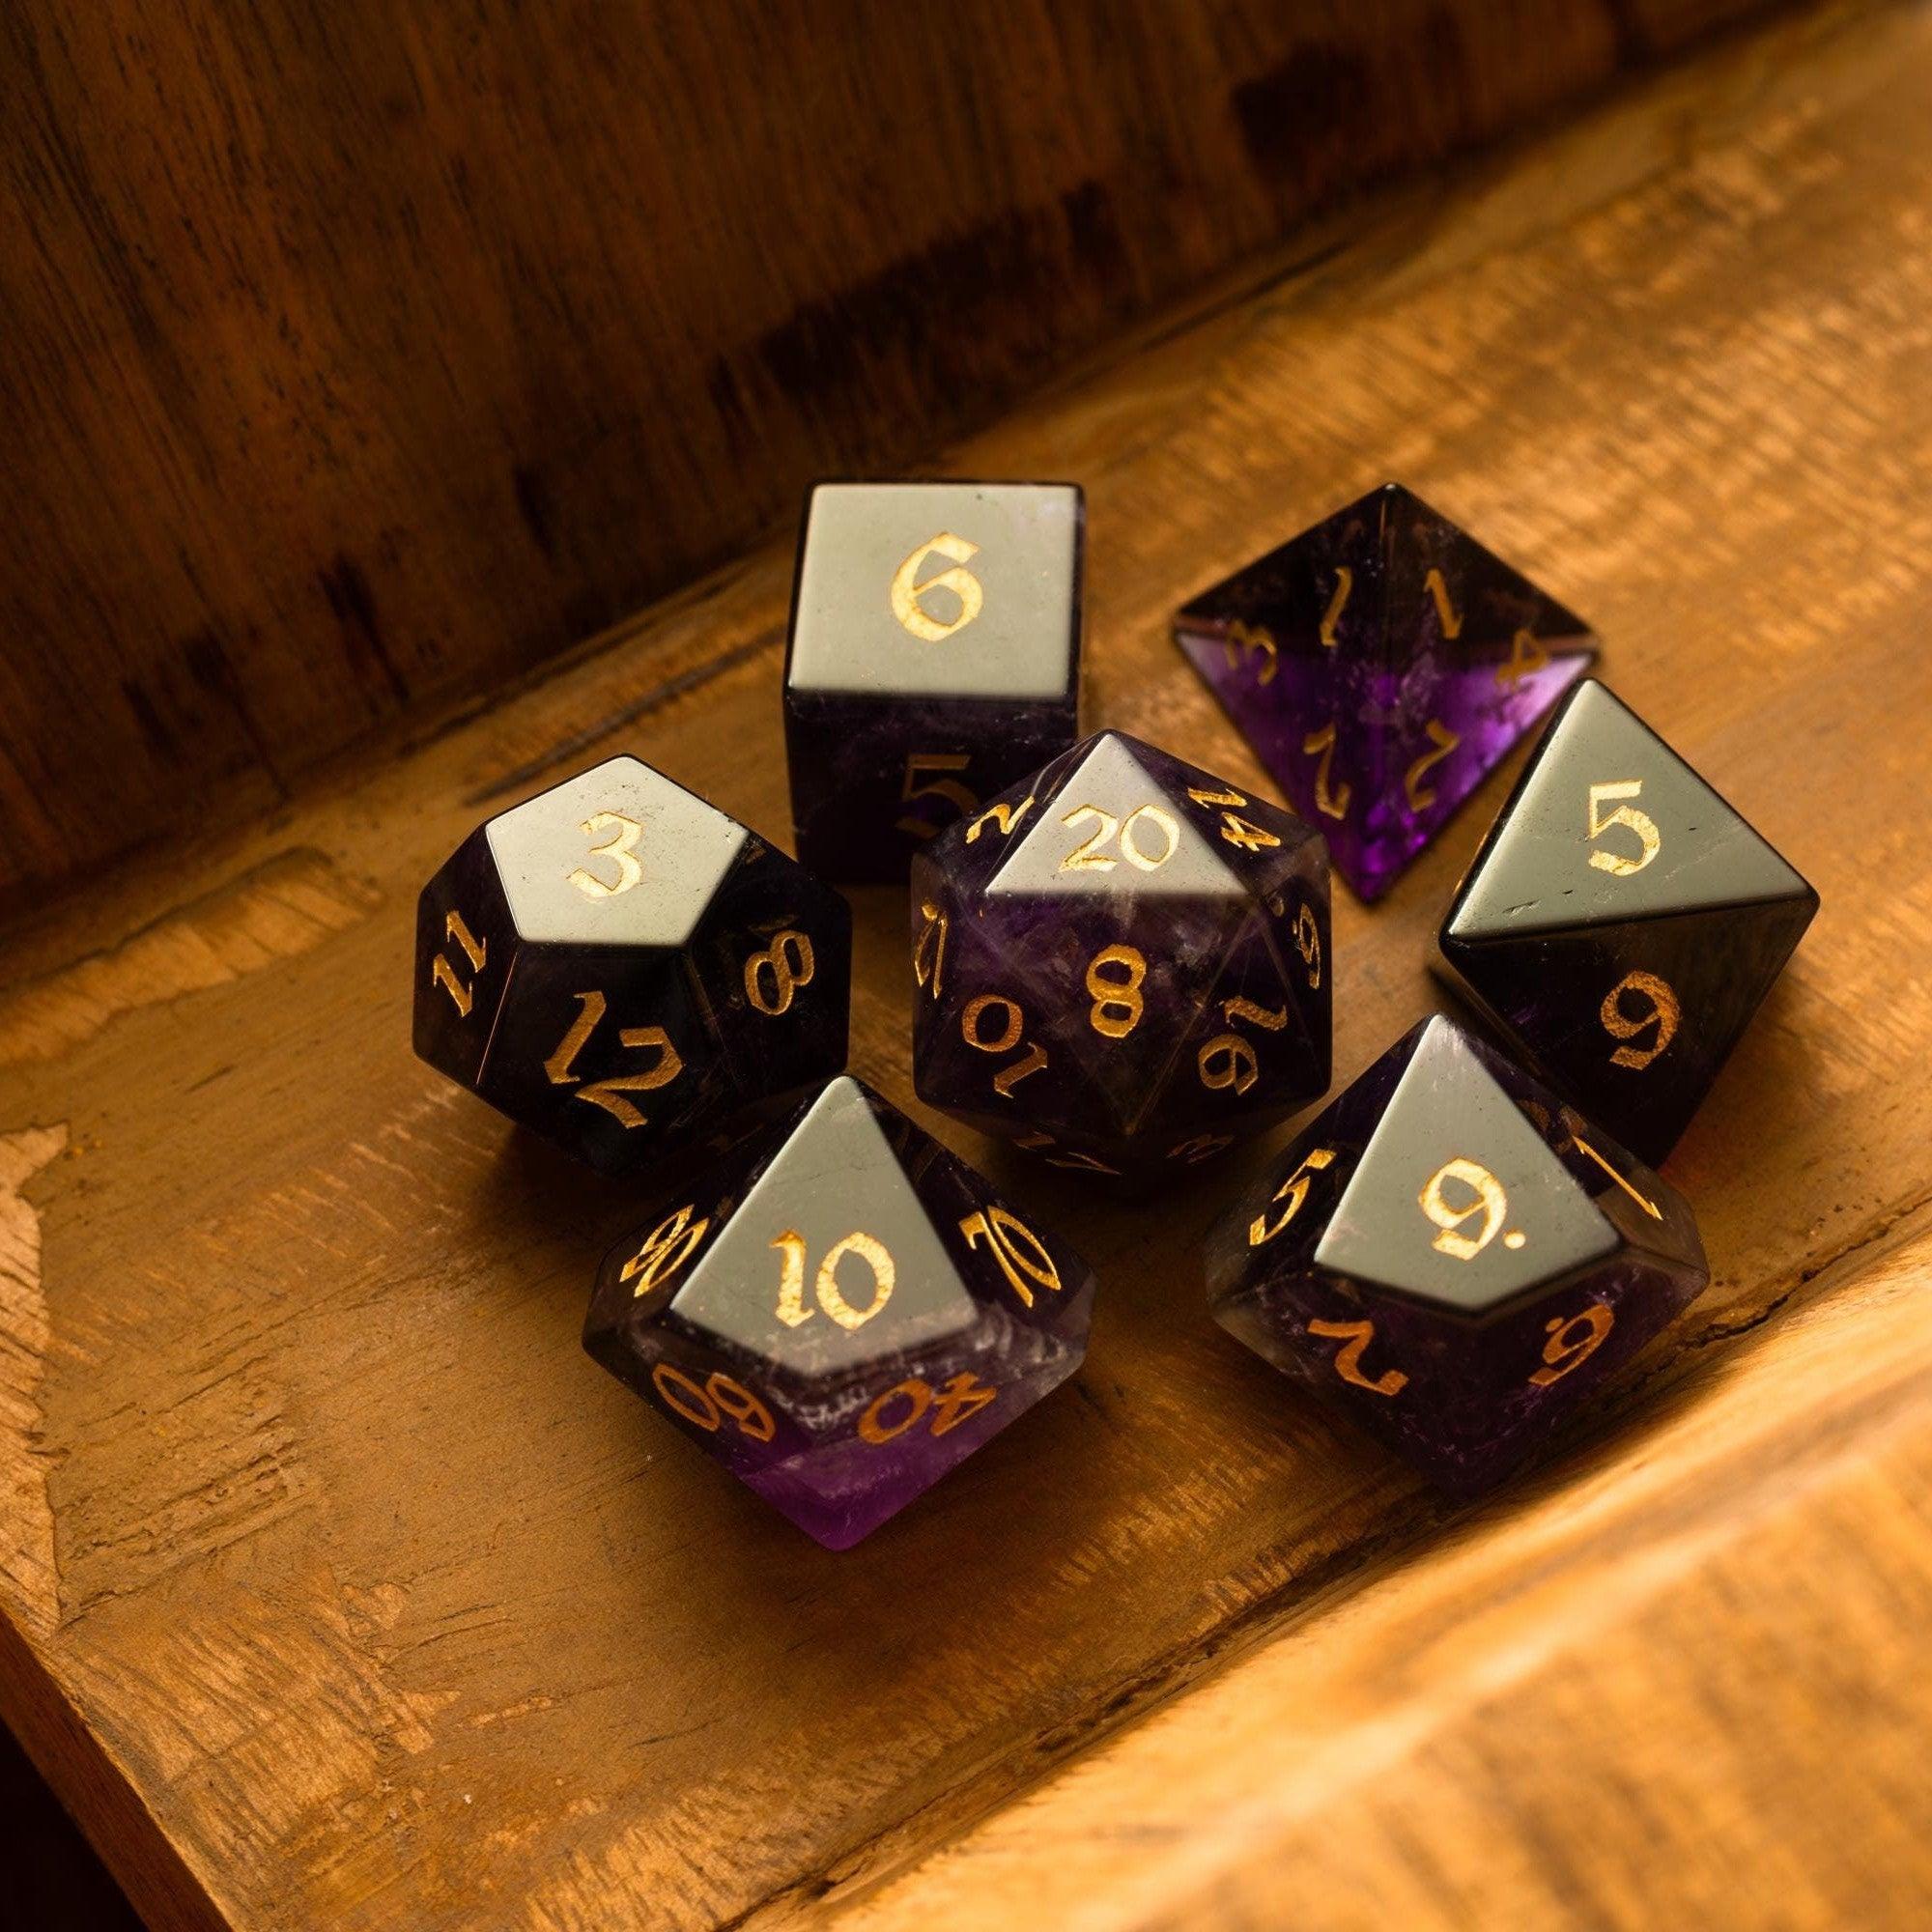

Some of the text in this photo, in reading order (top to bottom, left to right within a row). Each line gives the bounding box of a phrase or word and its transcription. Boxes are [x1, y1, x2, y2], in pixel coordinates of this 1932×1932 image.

[891, 531, 983, 641] 6
[1319, 566, 1351, 647] 1
[1424, 569, 1463, 639] 1
[1303, 722, 1350, 820] 2
[1405, 719, 1461, 812] 2
[566, 810, 644, 902] 3
[1058, 804, 1181, 872] 20
[1588, 780, 1661, 877] 5
[433, 910, 487, 1017] 11
[744, 929, 815, 1016] 8
[1085, 944, 1148, 1038] 8
[543, 991, 687, 1128] 12
[1249, 1149, 1337, 1246] 5
[770, 1228, 896, 1331] 10
[958, 1205, 1062, 1309] 70
